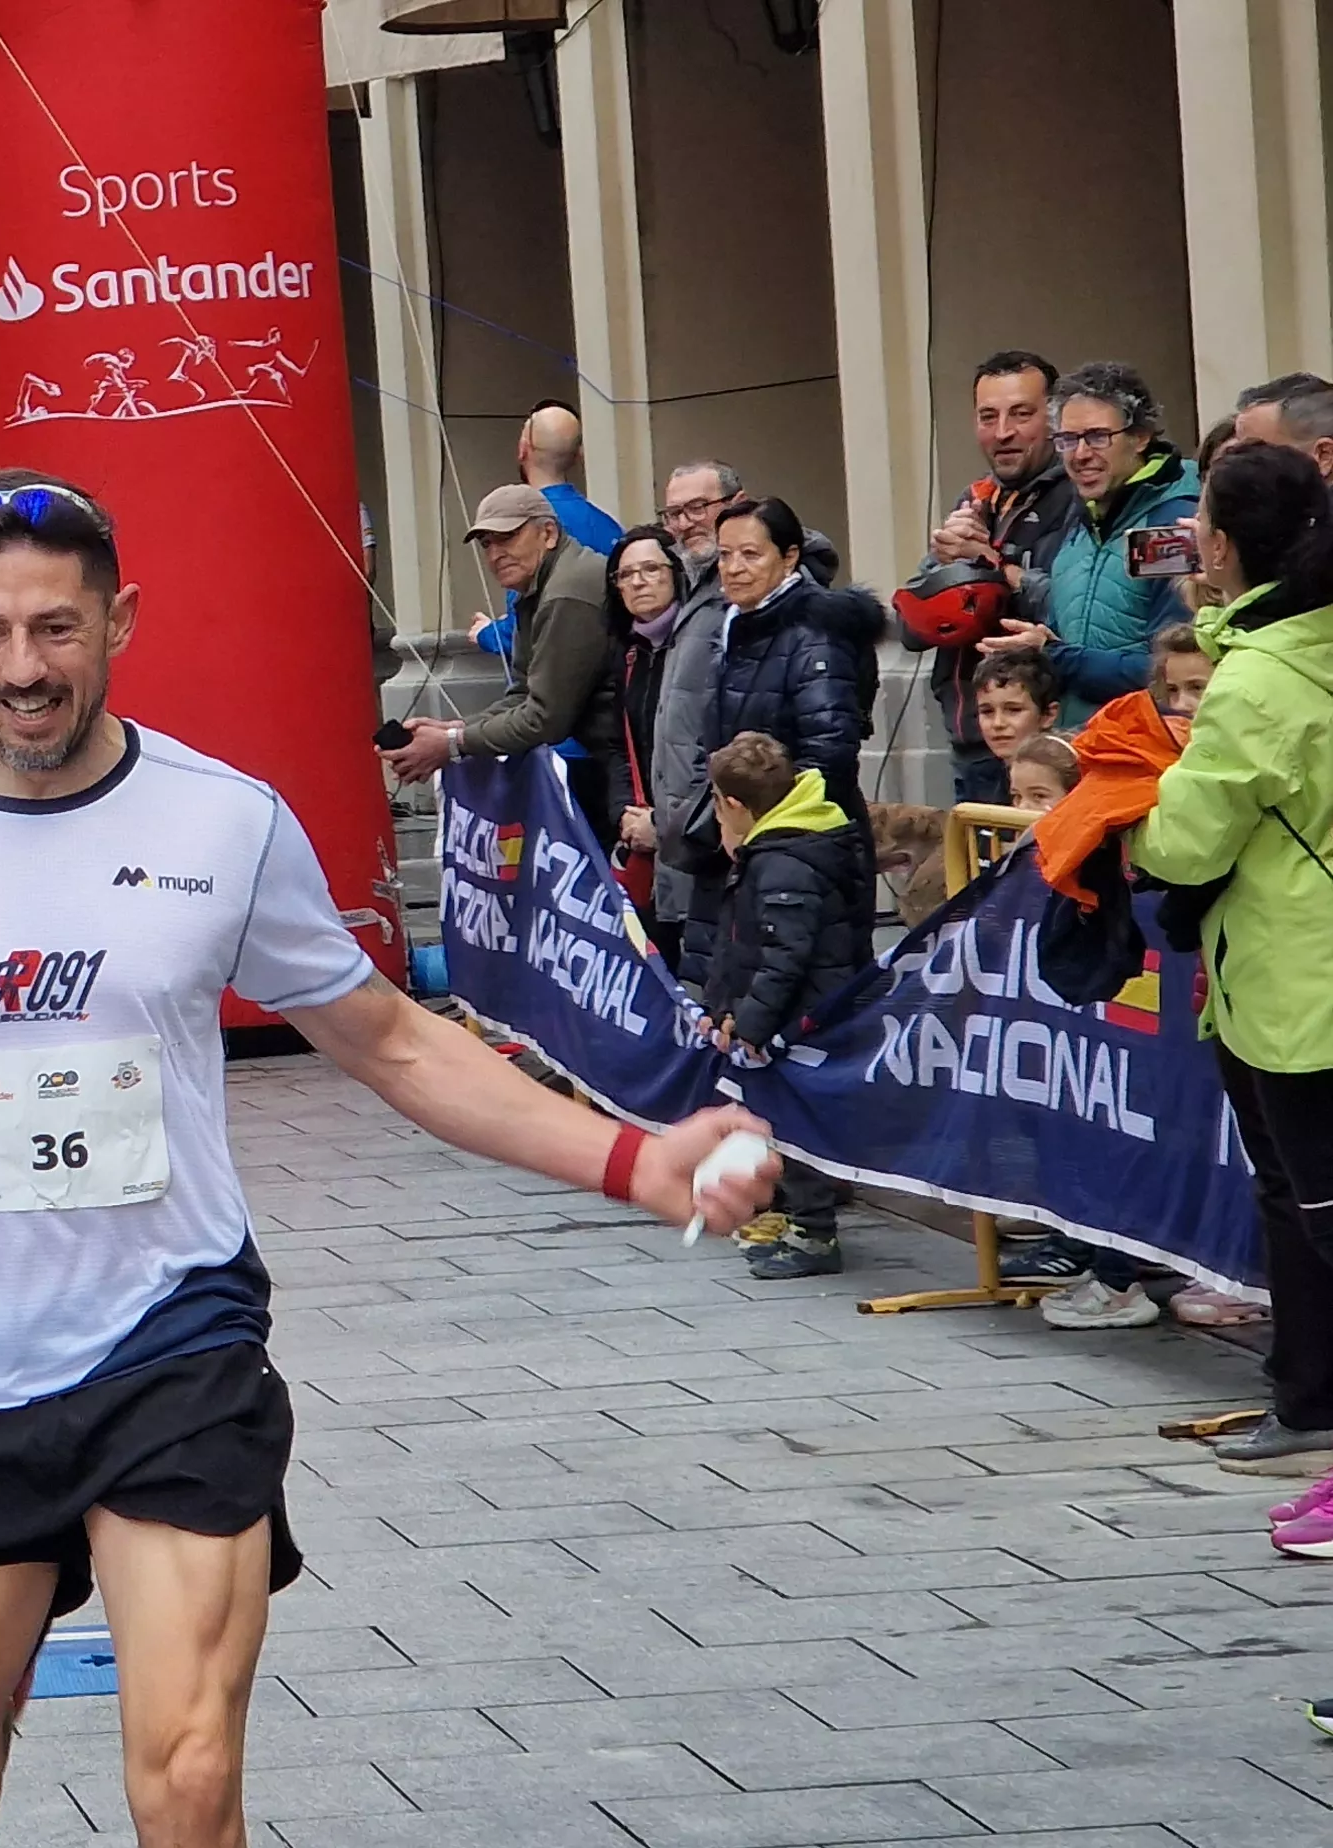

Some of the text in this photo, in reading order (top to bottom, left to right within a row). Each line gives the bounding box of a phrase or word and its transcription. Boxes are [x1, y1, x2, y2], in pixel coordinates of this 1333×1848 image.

[59, 161, 238, 228] Sports
[52, 251, 314, 313] Santander
[158, 874, 215, 896] mupol
[865, 1012, 1156, 1142] NACIONAL
[30, 1130, 89, 1172] 36
